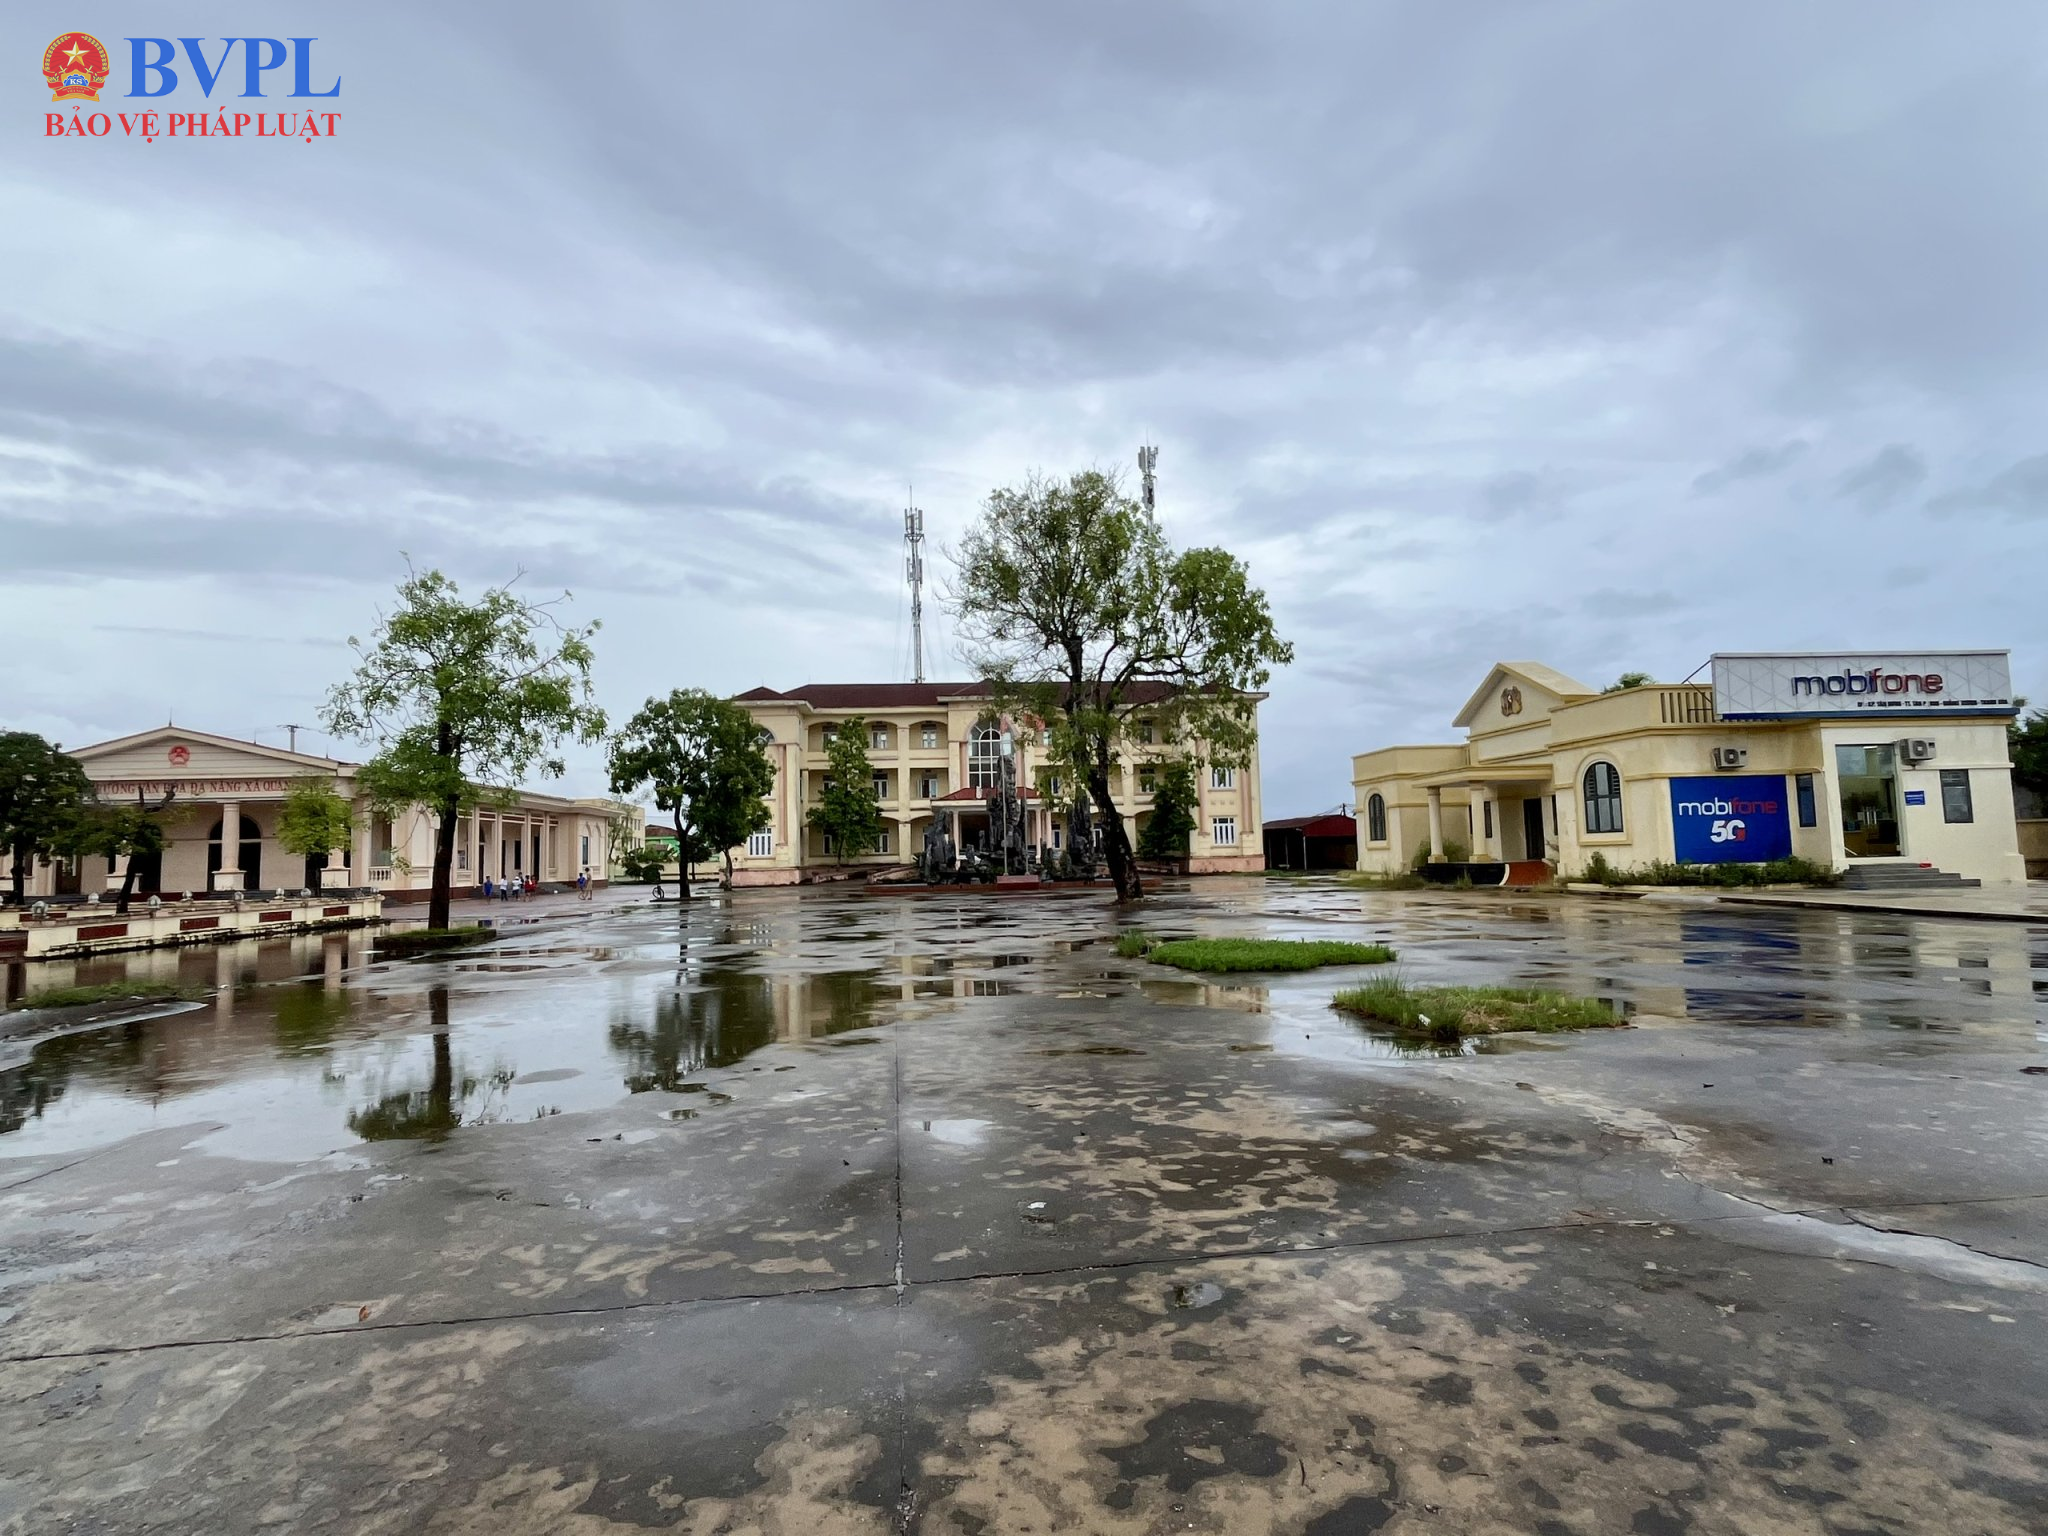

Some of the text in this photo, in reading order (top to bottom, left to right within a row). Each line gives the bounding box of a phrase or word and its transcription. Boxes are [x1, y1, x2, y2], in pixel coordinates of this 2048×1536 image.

[1791, 668, 1943, 695] mobifone
[1679, 797, 1777, 816] mobifone
[1710, 819, 1746, 843] 5G
